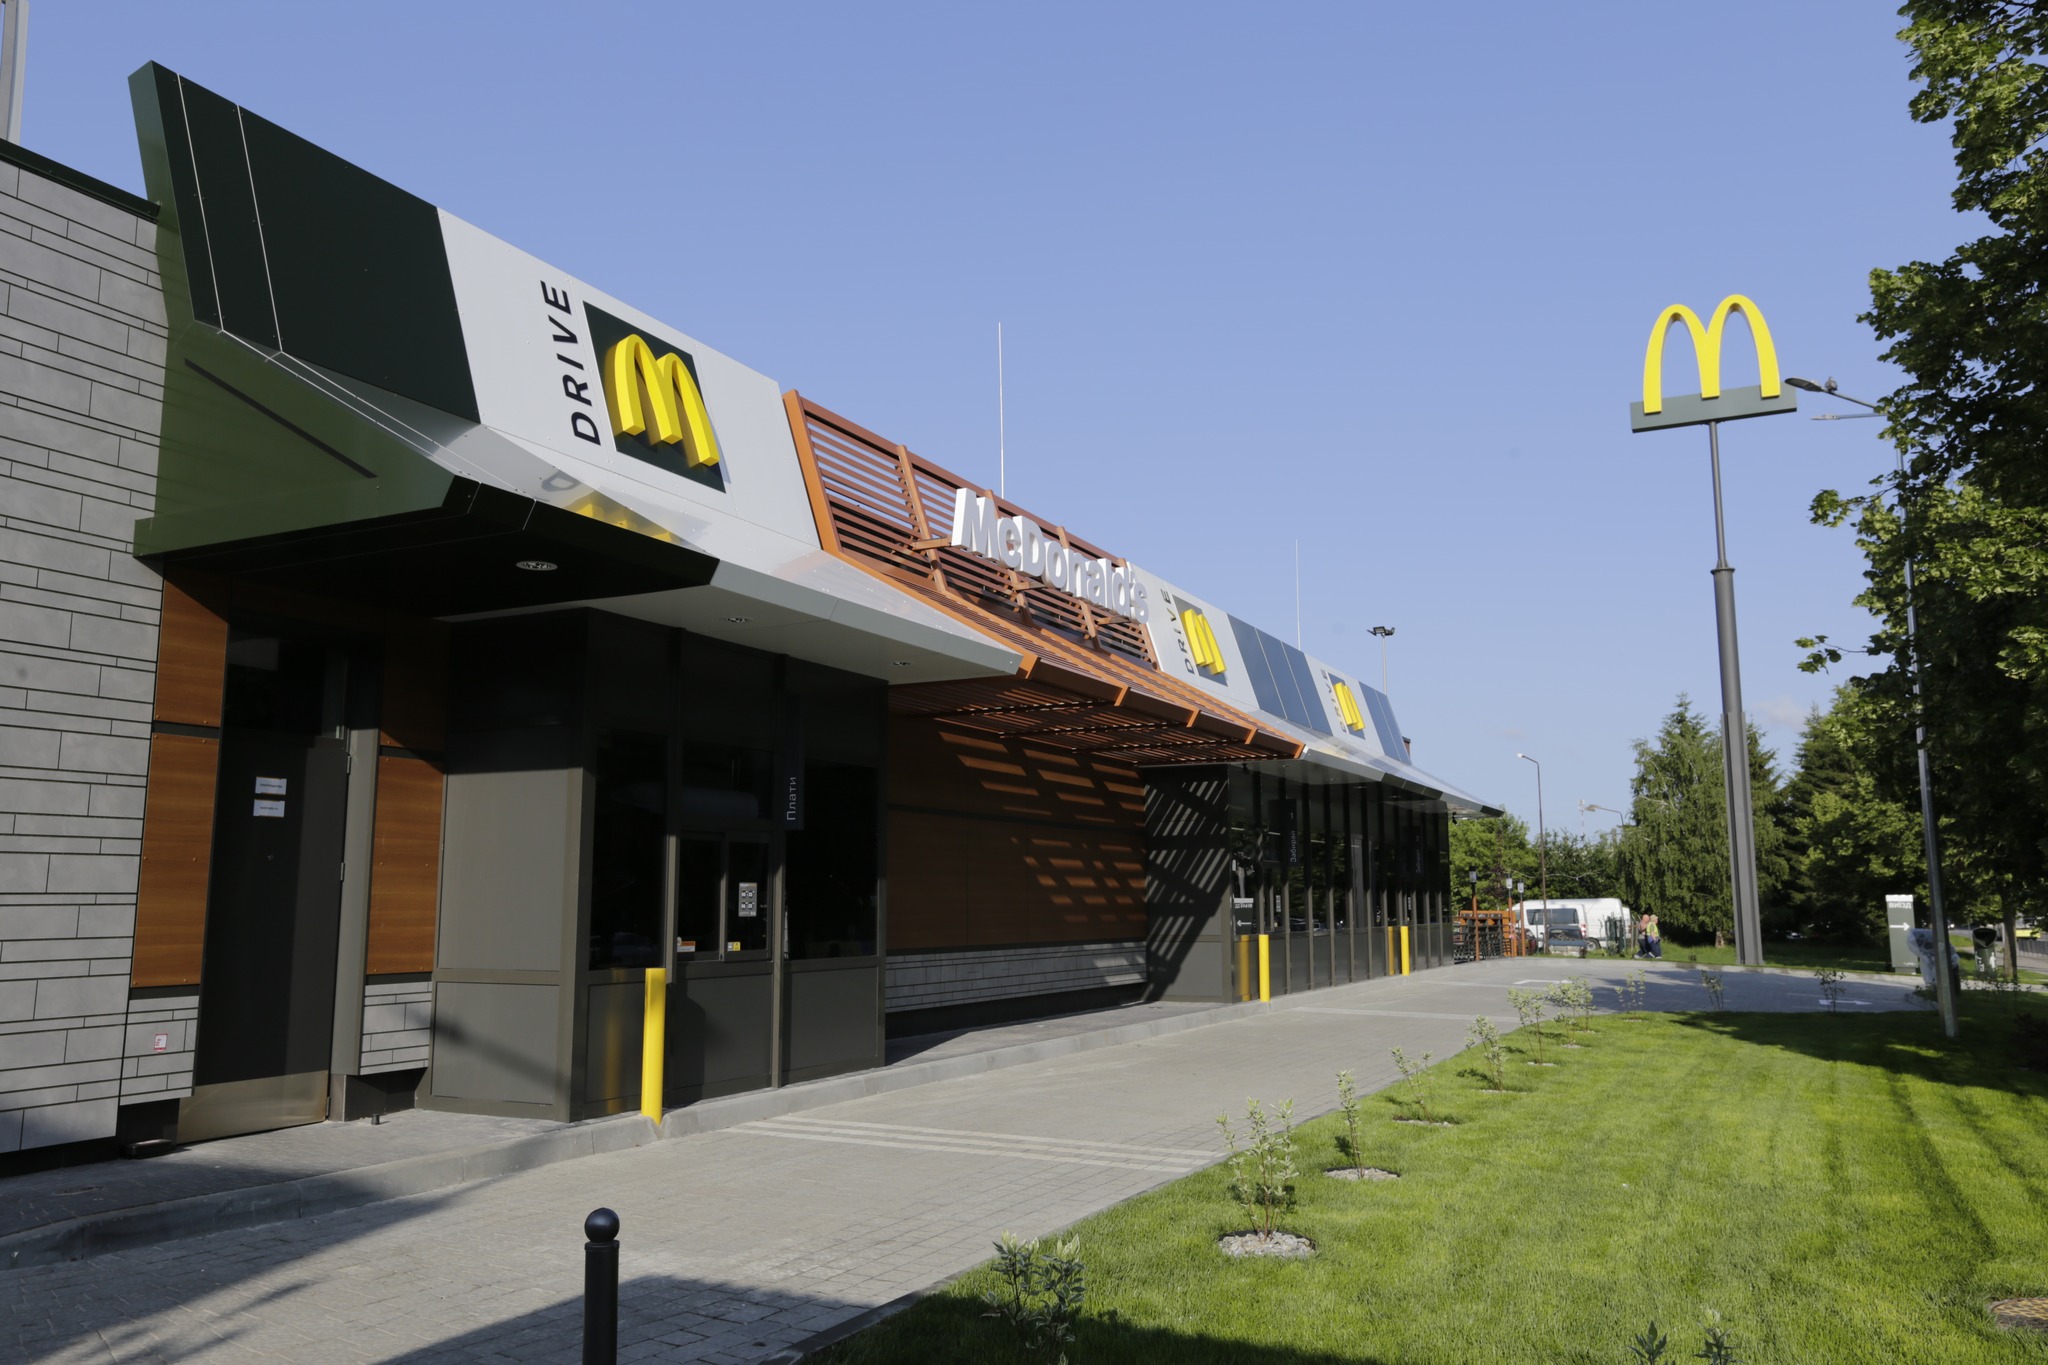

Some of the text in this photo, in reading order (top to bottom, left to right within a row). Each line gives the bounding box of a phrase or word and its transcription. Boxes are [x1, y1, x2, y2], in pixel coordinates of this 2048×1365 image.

[540, 280, 601, 446] DRIVE
[951, 487, 1149, 625] McDonald's
[1160, 588, 1195, 674] DRIVE
[786, 776, 796, 820] Плати
